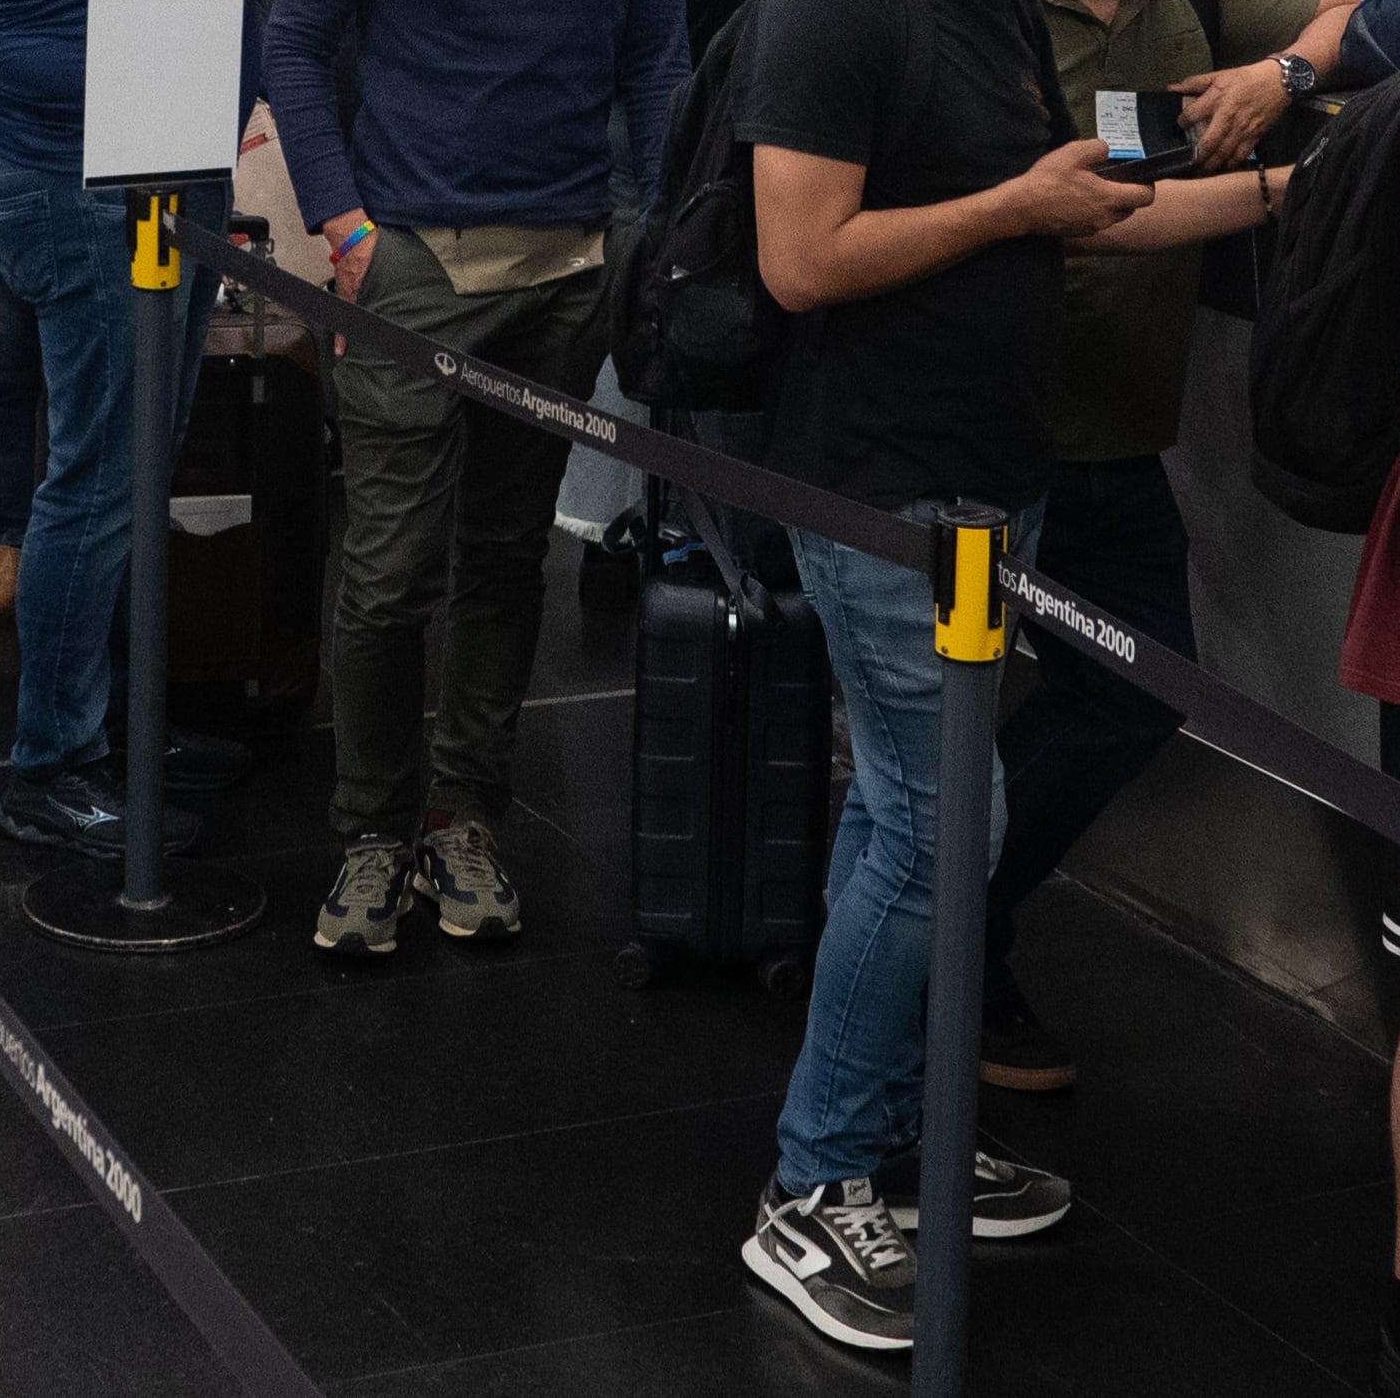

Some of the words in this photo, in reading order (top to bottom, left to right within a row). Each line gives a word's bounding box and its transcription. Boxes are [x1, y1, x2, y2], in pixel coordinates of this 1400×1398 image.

[460, 362, 521, 406] Aeropuertos
[522, 387, 585, 431] Argentina
[585, 412, 616, 444] 2000
[1017, 572, 1095, 641] Argentina
[1096, 618, 1136, 664] 2000
[36, 1063, 105, 1178] Argentina
[106, 1150, 142, 1224] 2000
